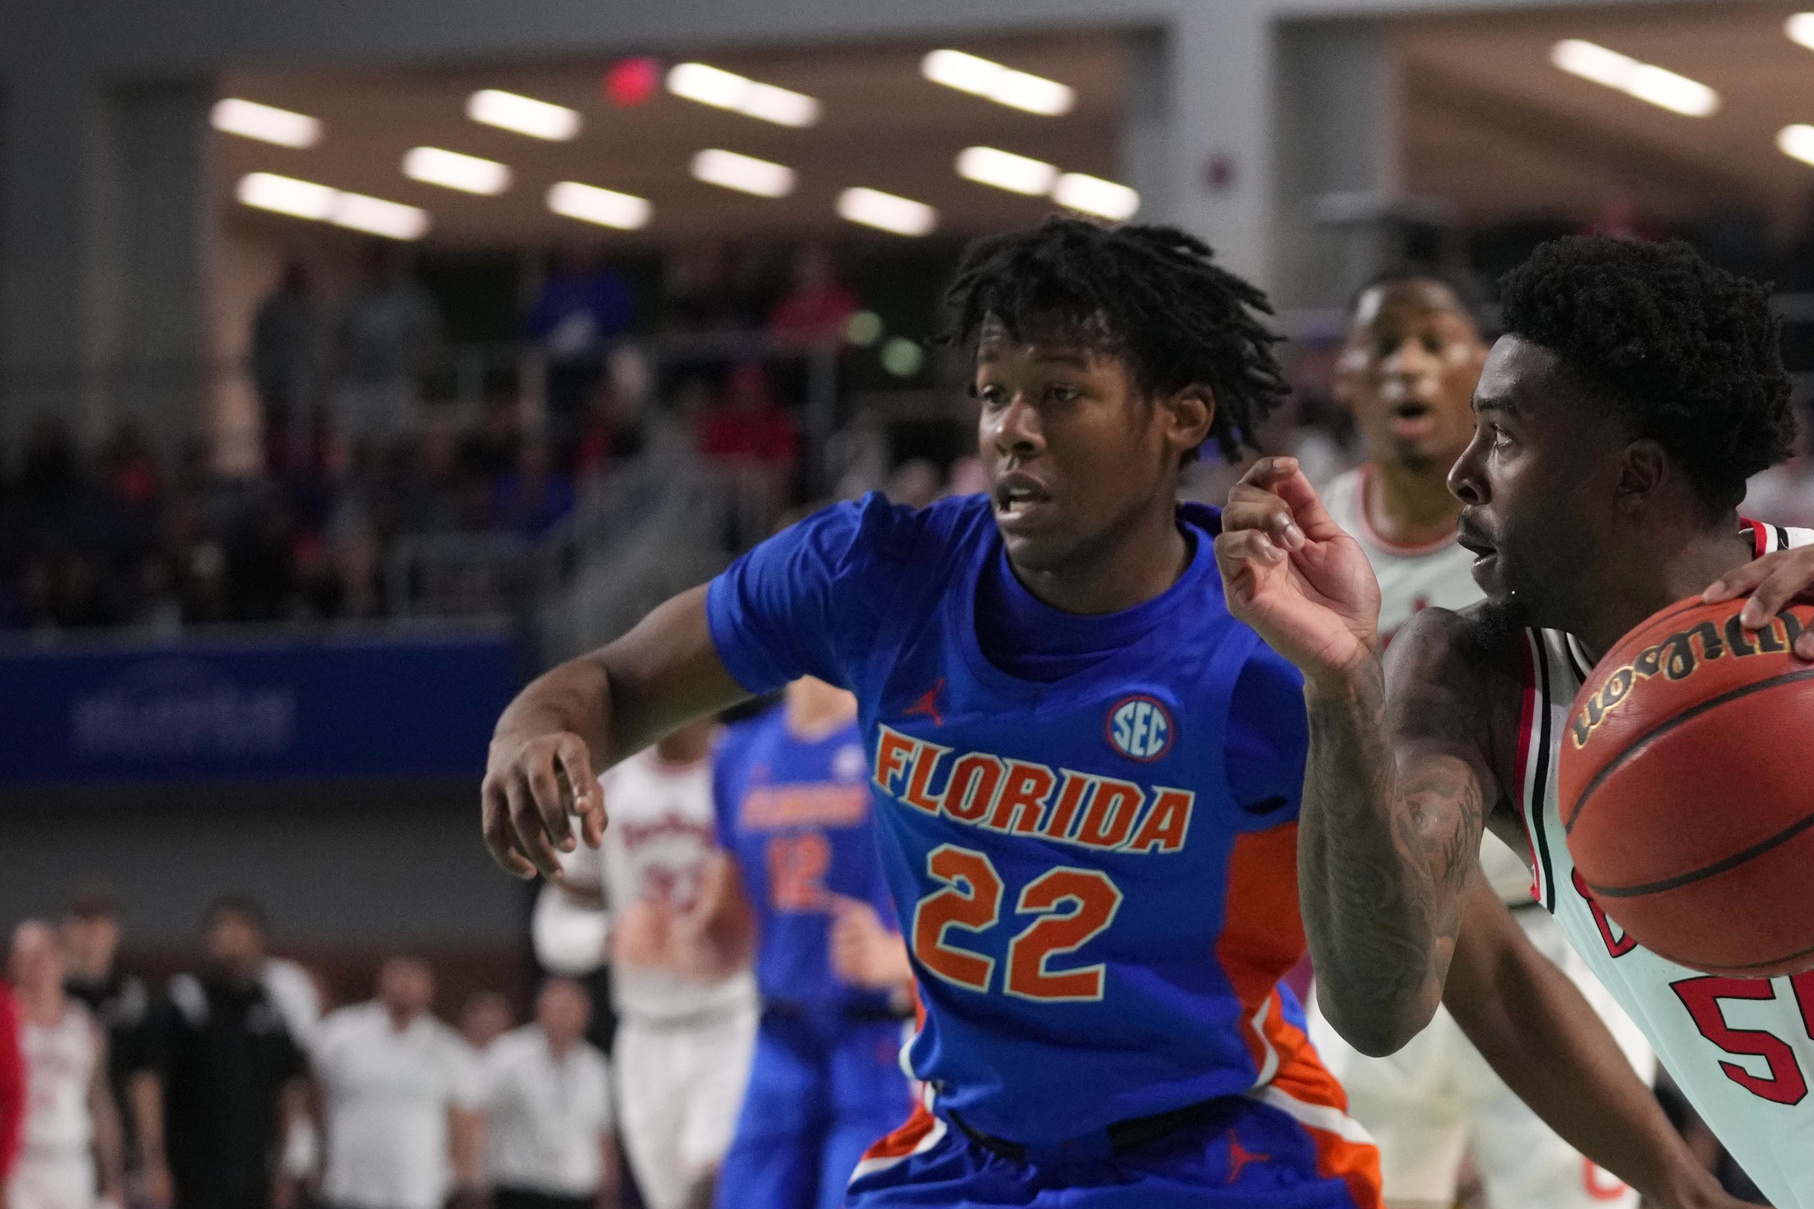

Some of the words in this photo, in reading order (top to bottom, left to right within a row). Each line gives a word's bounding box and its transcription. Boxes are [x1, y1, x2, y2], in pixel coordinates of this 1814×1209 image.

[872, 723, 1195, 854] FLORIDA
[1113, 701, 1168, 757] SEC
[912, 843, 1124, 1002] 22
